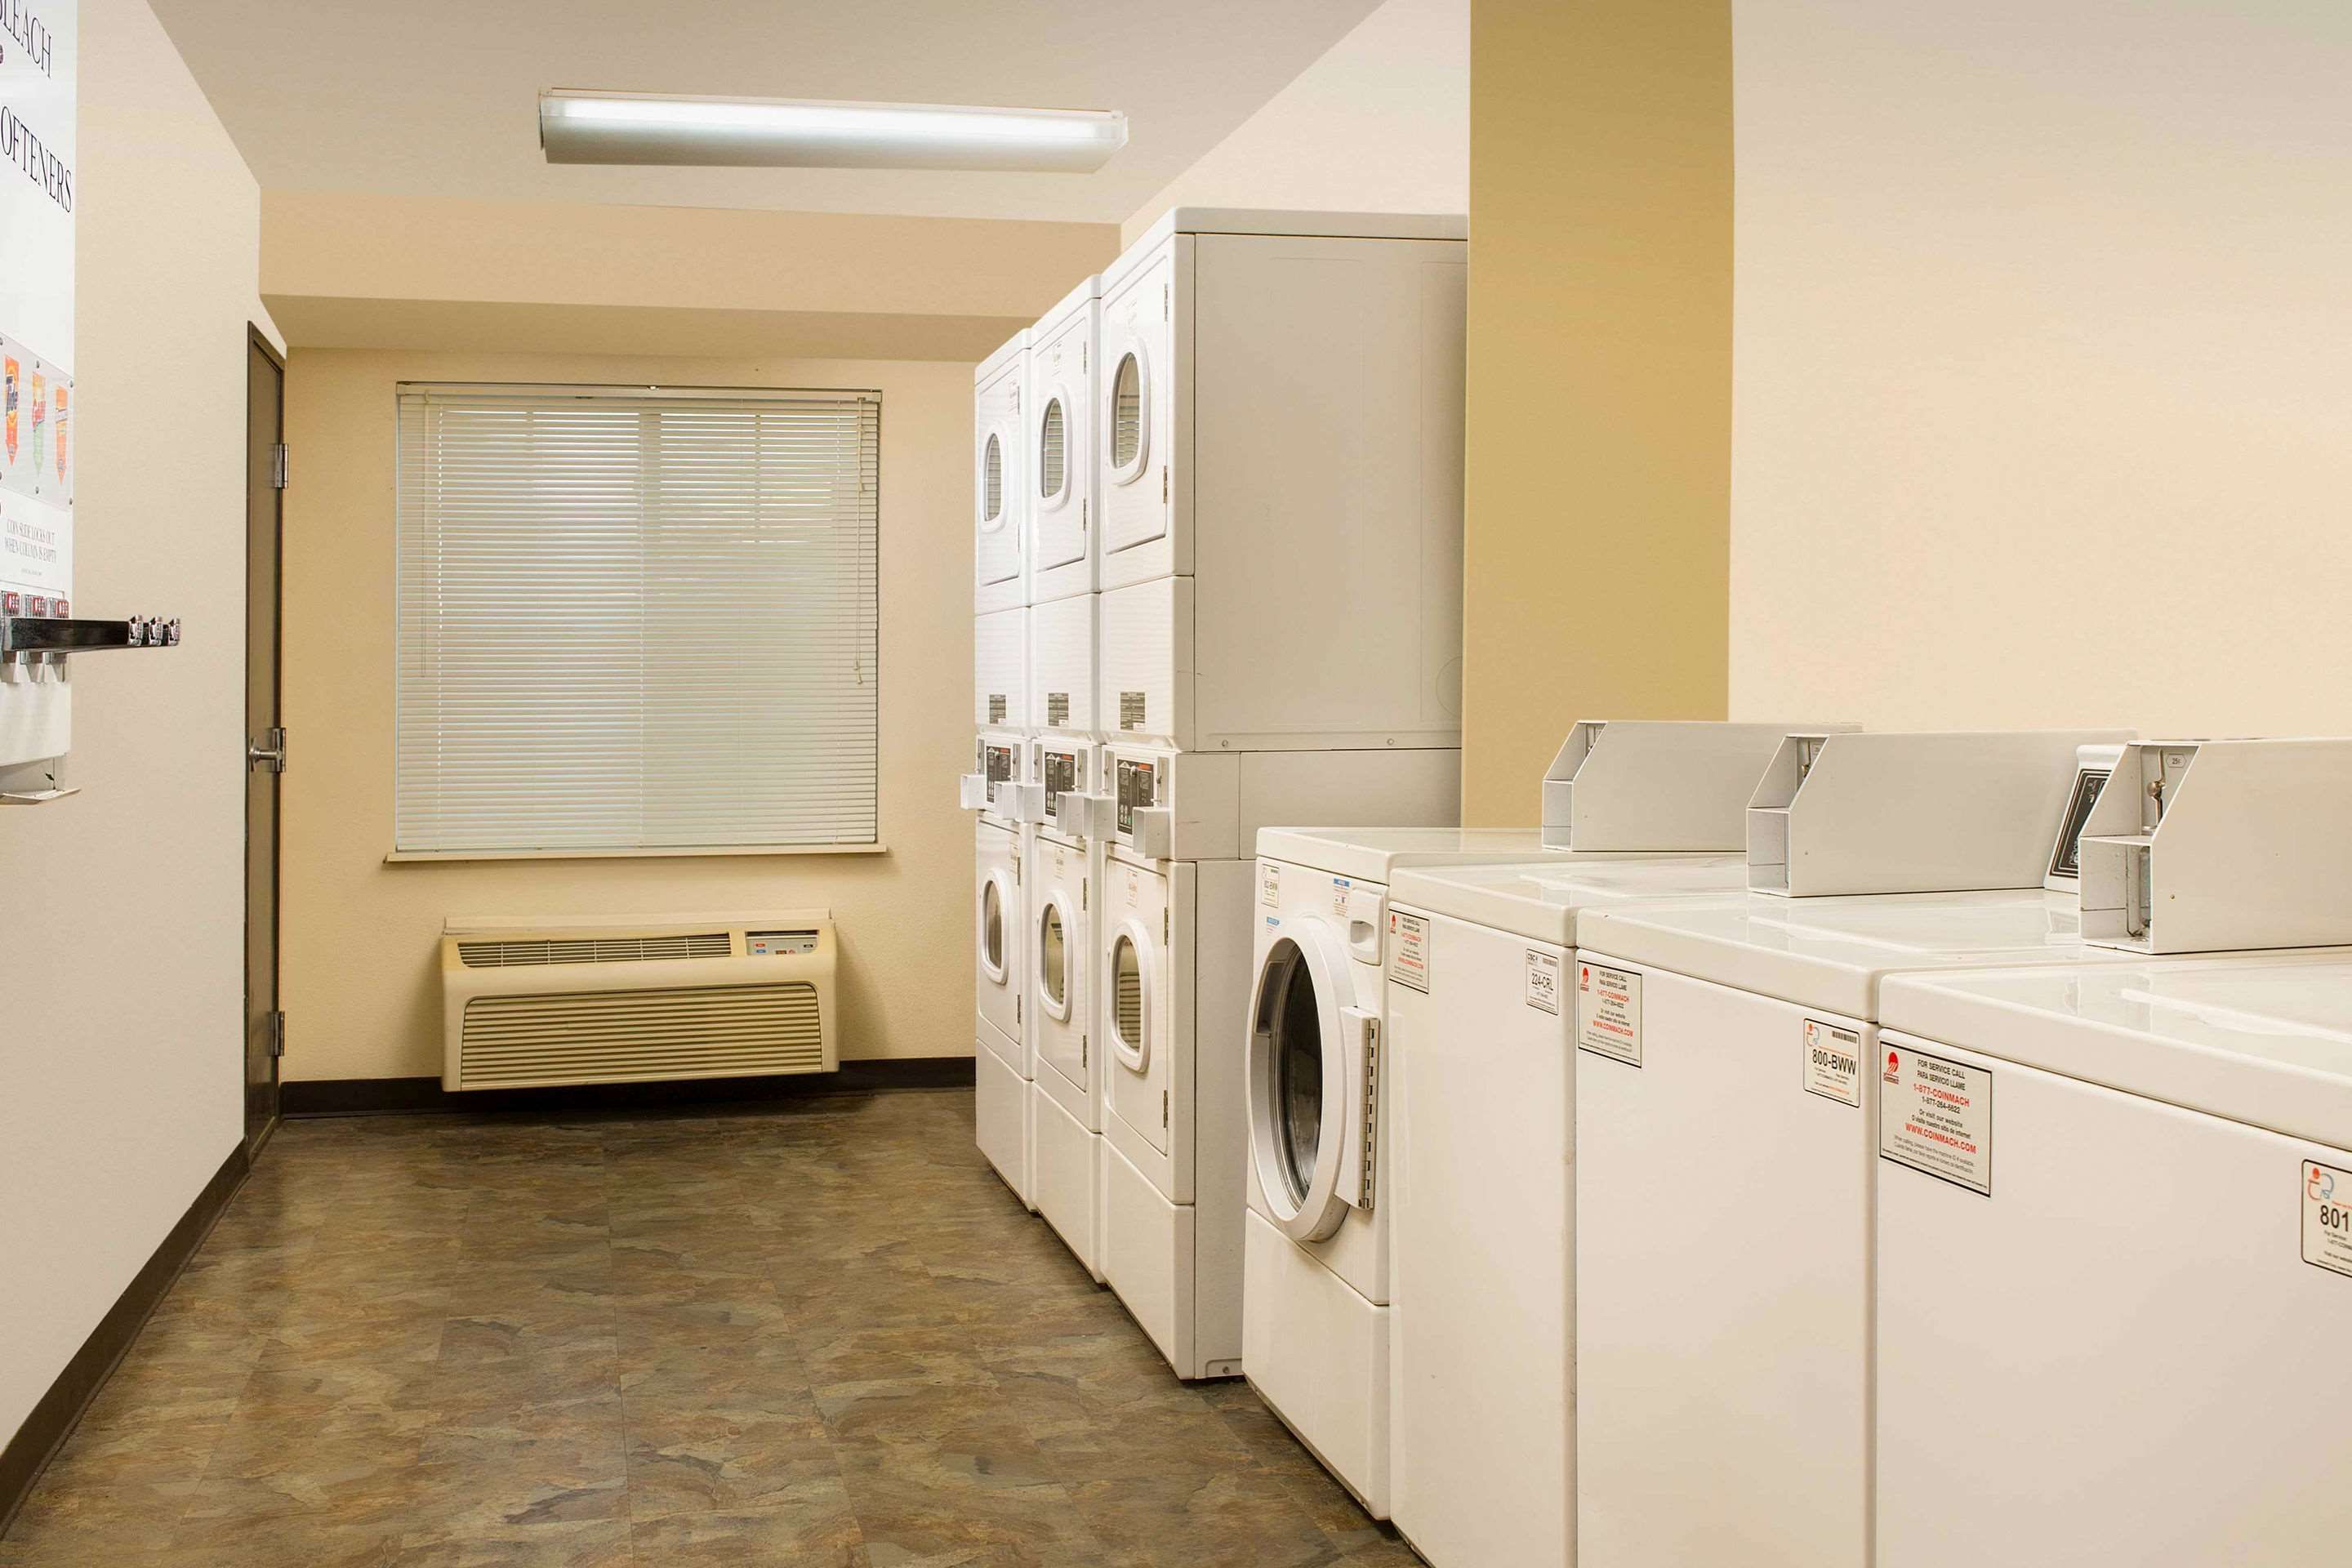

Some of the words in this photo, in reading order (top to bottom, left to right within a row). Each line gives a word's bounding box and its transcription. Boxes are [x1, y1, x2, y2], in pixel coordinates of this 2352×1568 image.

[1812, 1049, 1856, 1075] 800-BWW
[1918, 1059, 1928, 1068] FOR
[1929, 1062, 1951, 1076] SERVICE
[1951, 1068, 1965, 1080] CALL
[1913, 1083, 1970, 1107] 1-877-COINMACH
[1950, 1080, 1966, 1090] LLAME
[1904, 1123, 1977, 1154] WWW.COINMACH.COM
